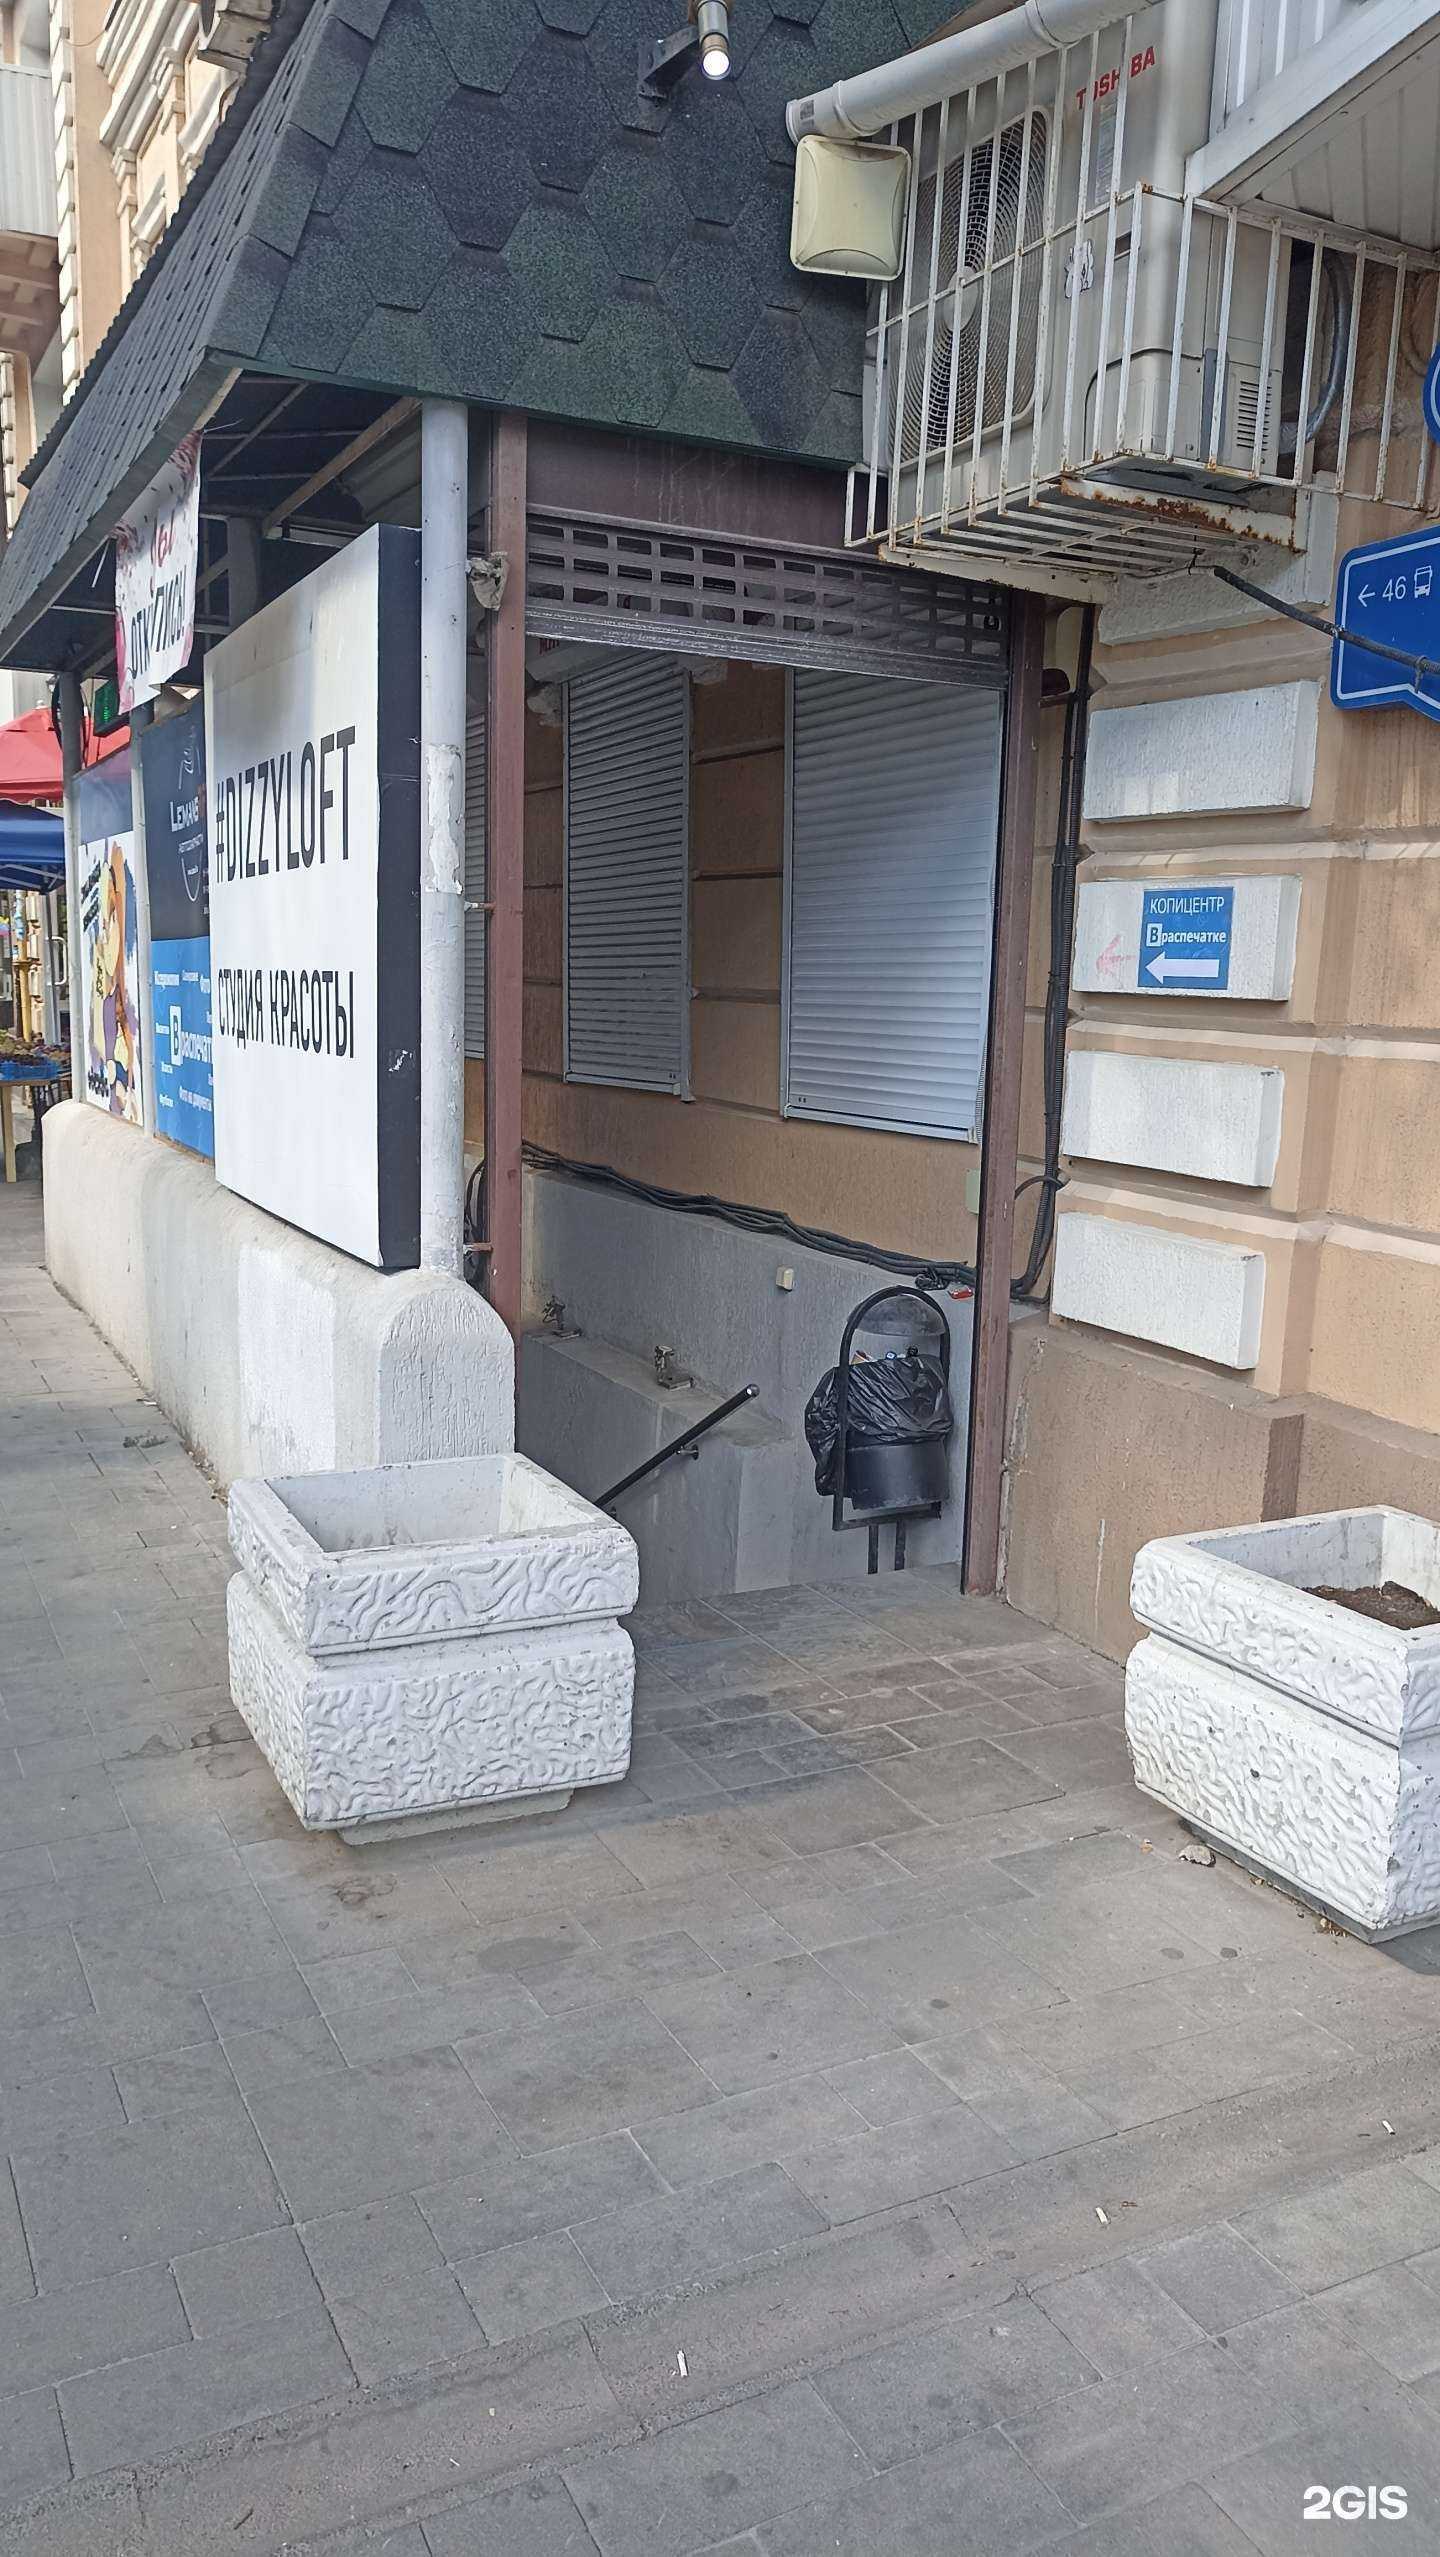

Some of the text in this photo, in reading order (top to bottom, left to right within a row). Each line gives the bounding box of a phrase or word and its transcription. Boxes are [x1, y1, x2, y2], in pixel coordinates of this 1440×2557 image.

[1382, 575, 1407, 602] 46
[216, 725, 356, 884] #DIZZYLOFT
[1150, 896, 1225, 916] КОПИЦЕНТР
[218, 968, 354, 1059] СТУДИЯ КРАСОТЫ
